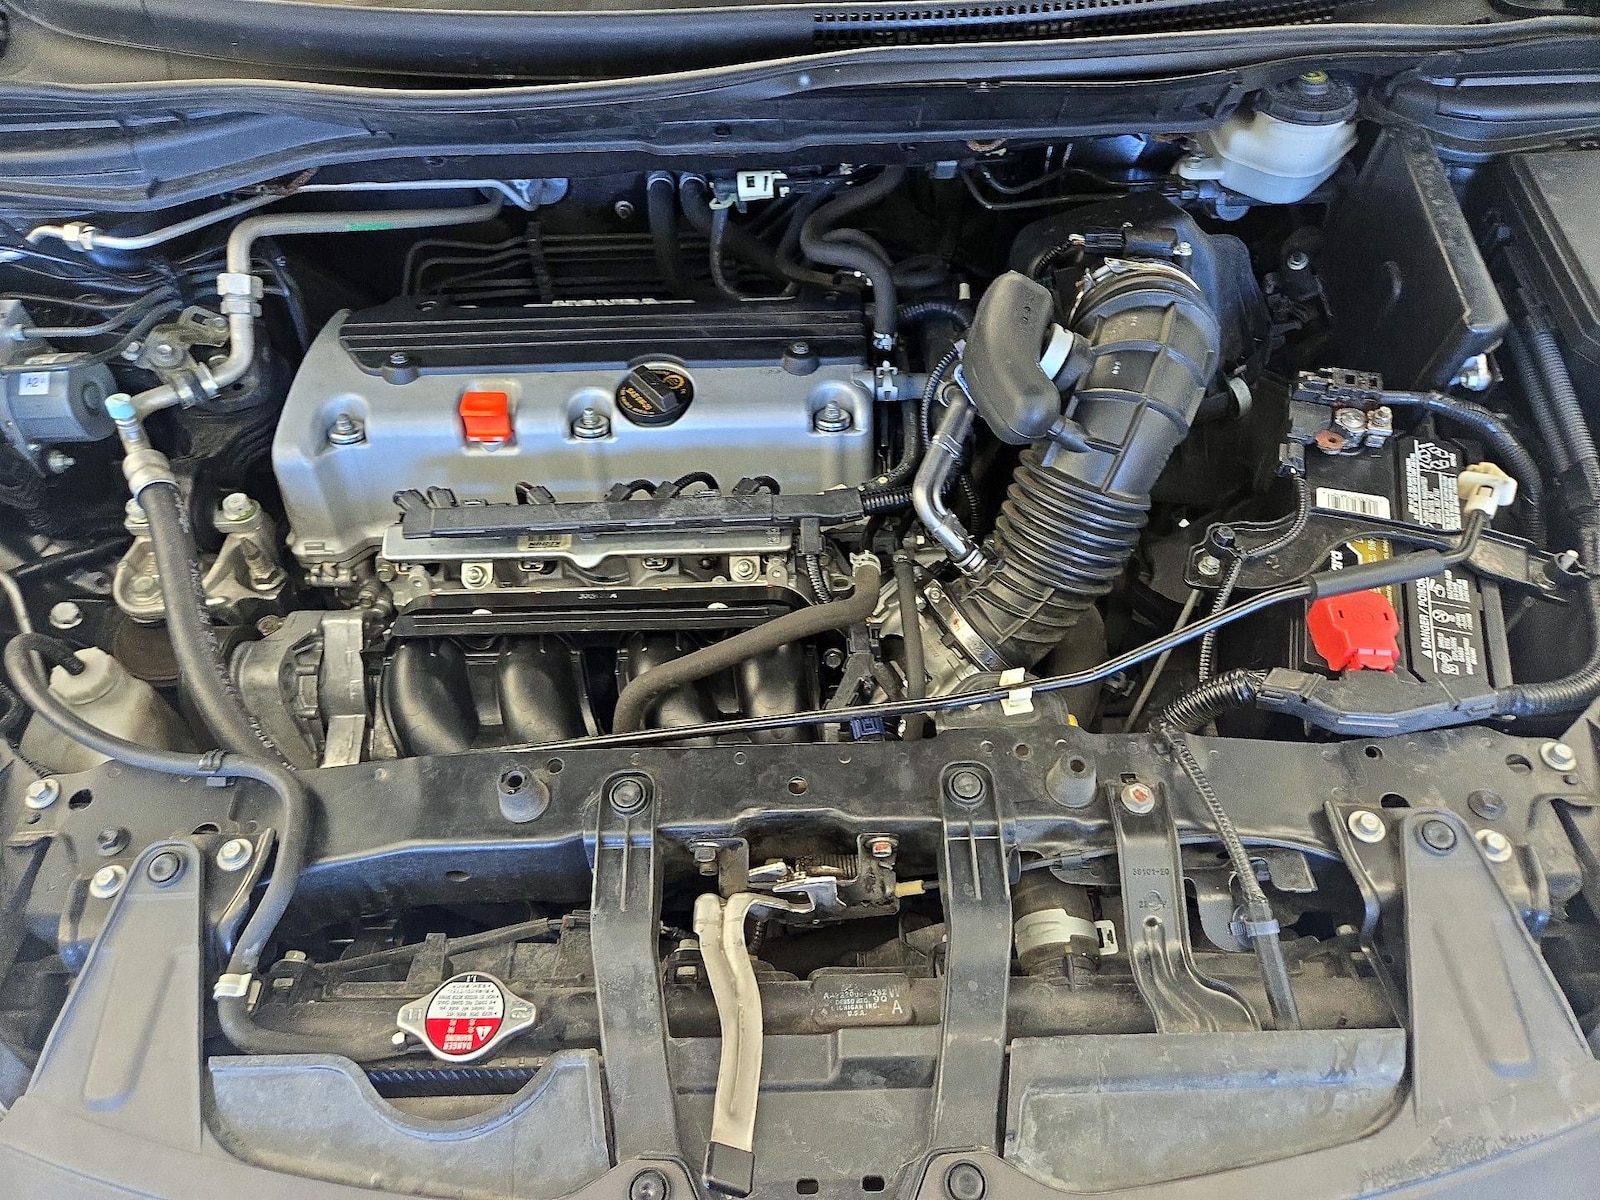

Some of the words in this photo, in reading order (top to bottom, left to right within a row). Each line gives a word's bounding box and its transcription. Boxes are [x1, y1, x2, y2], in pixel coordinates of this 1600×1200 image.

[1415, 577, 1429, 608] POISON
[1419, 613, 1433, 650] DANGER
[891, 999, 903, 1015] A
[443, 1041, 473, 1051] DANGER
